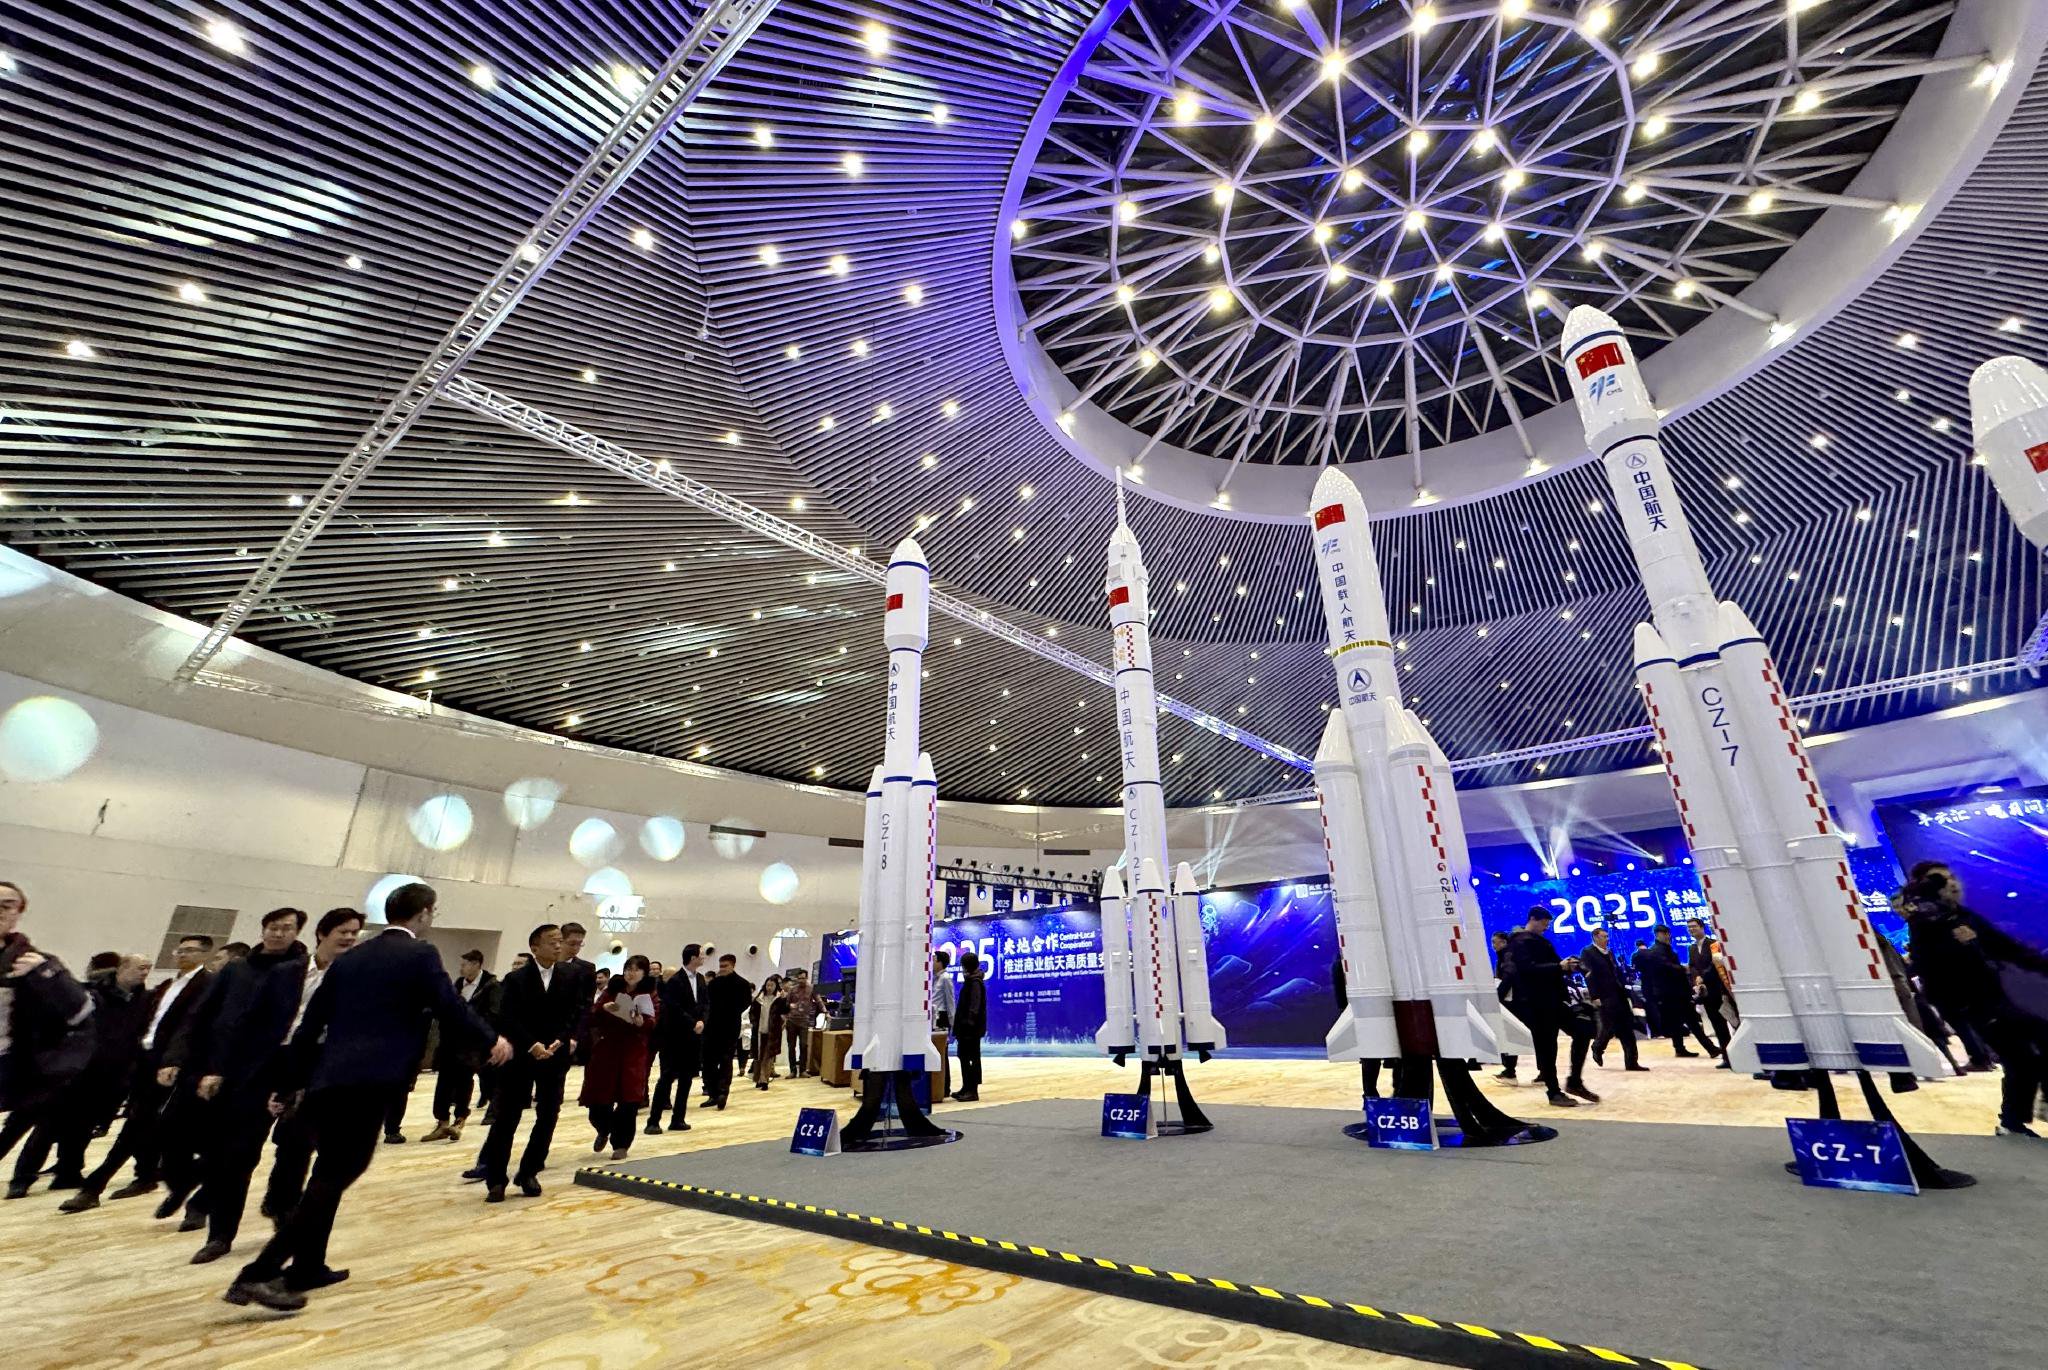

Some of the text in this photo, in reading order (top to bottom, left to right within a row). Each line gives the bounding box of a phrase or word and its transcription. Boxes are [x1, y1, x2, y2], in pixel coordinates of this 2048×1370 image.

[1633, 471, 1668, 532] 中国航天
[1332, 562, 1357, 643] 中国载人航天
[886, 681, 898, 741] 中国航天
[1348, 691, 1377, 706] 中国航天
[1119, 686, 1136, 770] 中国航天
[1701, 687, 1739, 767] CZ-7
[881, 813, 890, 870] CZ-8
[1129, 808, 1141, 886] CZ-2F
[1440, 877, 1455, 916] CZ-5B
[1550, 890, 1656, 934] 2025
[1664, 889, 1705, 906] 央地
[1003, 932, 1059, 955] 央地合作
[1059, 930, 1096, 941] Central-Local
[1059, 941, 1093, 950] Cooperation
[800, 1123, 825, 1137] CZ-8
[1110, 1108, 1140, 1121] CZ-2F
[1377, 1115, 1419, 1130] CZ-5B
[1811, 1142, 1882, 1165] CZ-7
